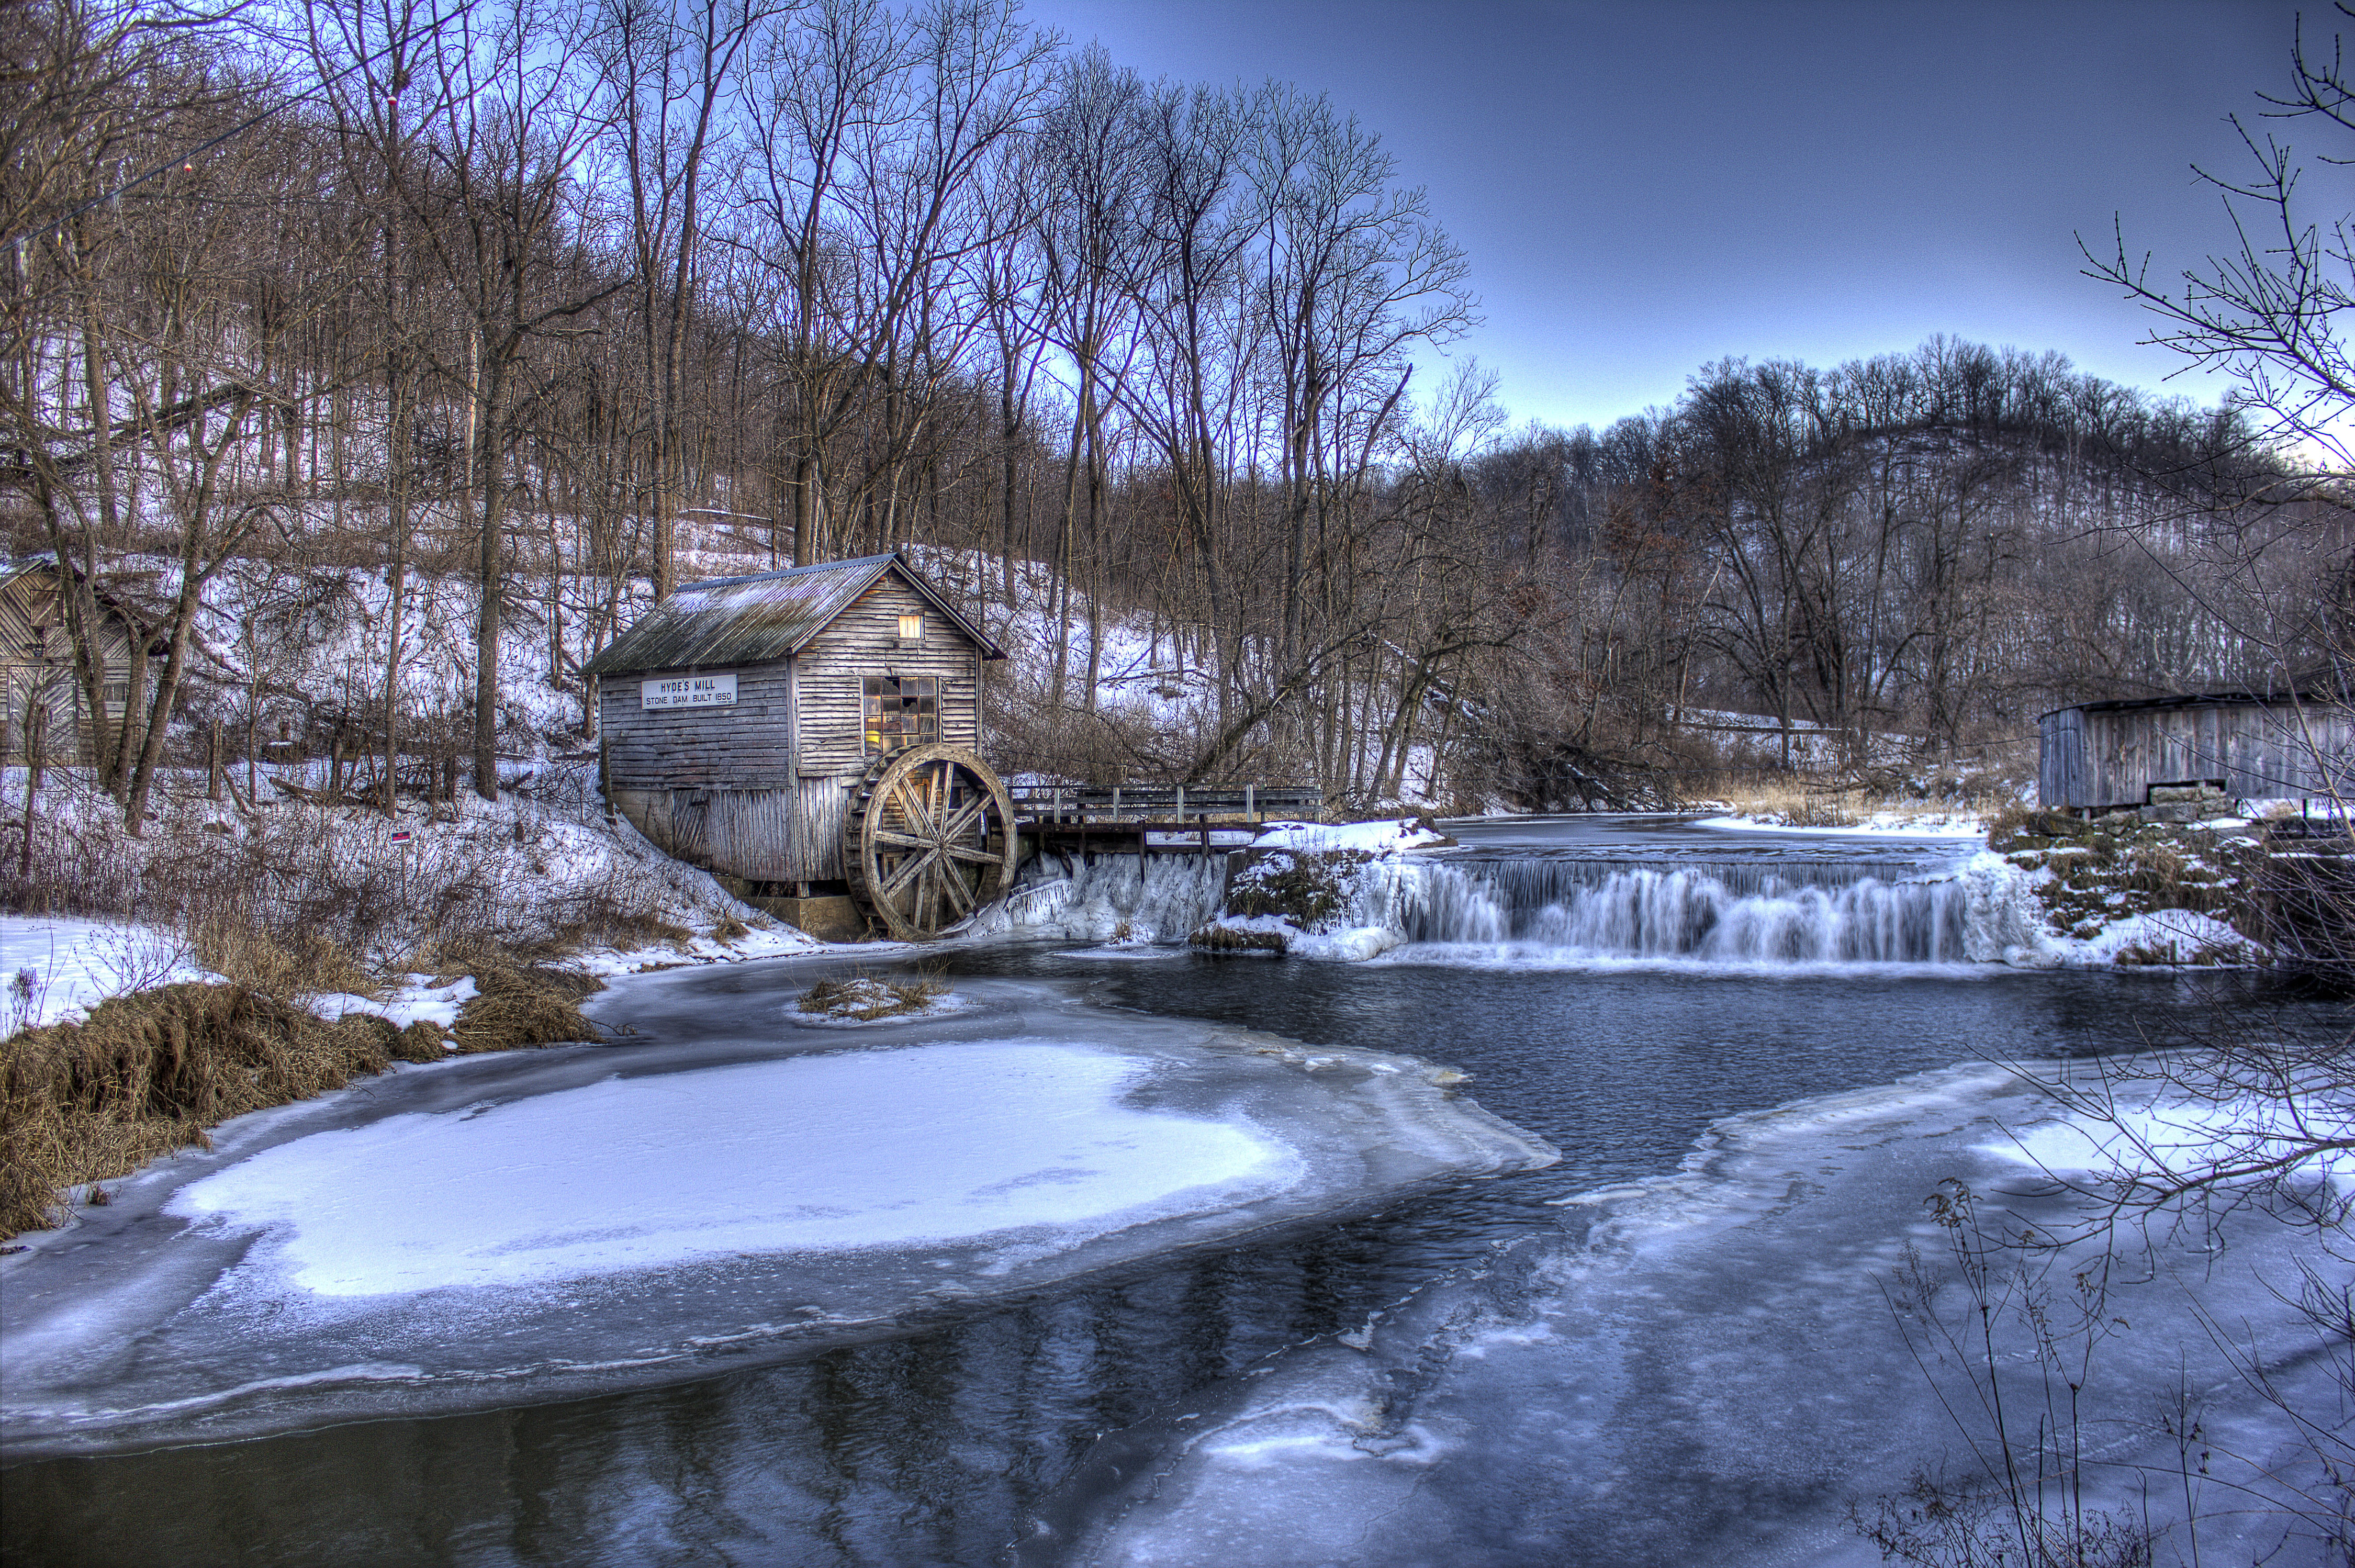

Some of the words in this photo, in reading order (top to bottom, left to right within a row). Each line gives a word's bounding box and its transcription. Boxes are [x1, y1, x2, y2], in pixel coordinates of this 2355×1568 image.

[661, 679, 689, 692] HYDE'S
[696, 680, 715, 690] MILL
[646, 697, 667, 705] STONE
[693, 694, 712, 702] BUILT
[715, 692, 732, 701] 1850
